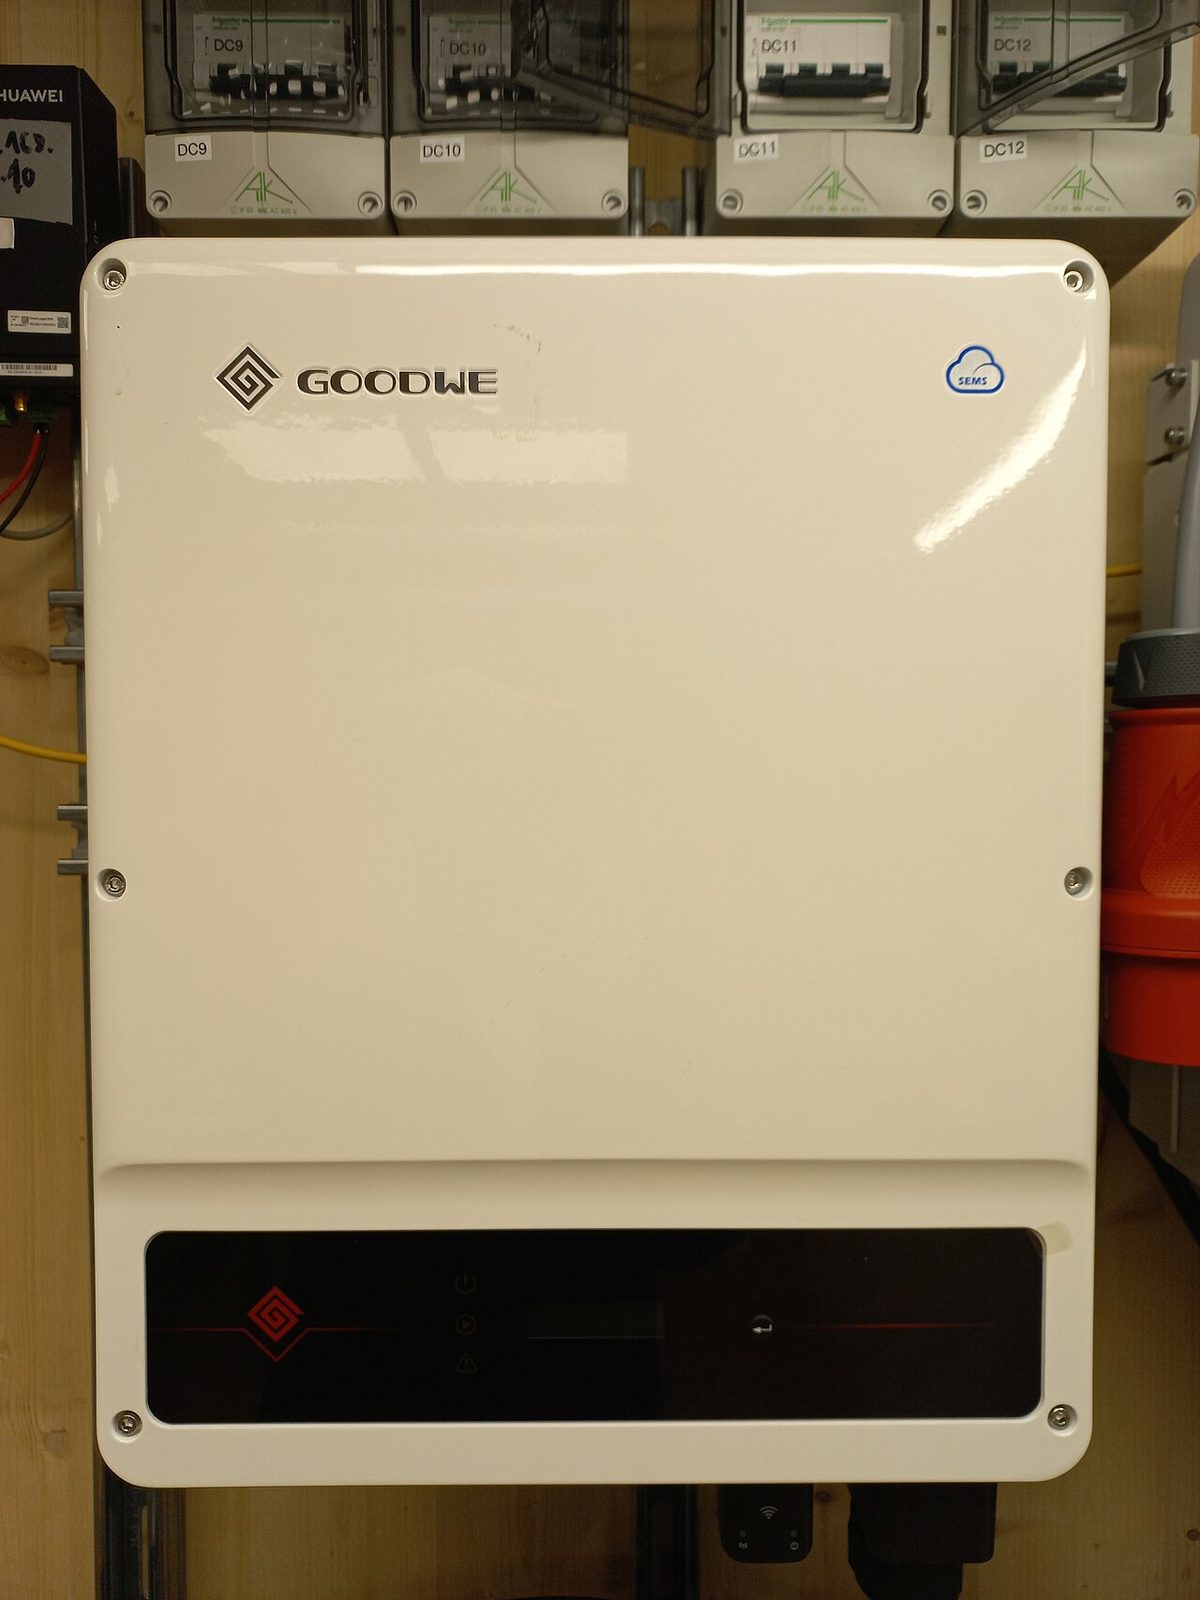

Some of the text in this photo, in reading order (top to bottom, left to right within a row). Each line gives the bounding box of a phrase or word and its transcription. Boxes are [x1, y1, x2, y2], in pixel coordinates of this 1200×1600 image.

[214, 38, 243, 52] DC9
[449, 42, 486, 56] DC10
[761, 38, 797, 53] DC11
[994, 38, 1031, 51] DC12
[0, 89, 64, 103] HUAWEI
[177, 142, 208, 157] DC9
[423, 144, 461, 158] DC10
[738, 141, 776, 157] DC11
[983, 140, 1025, 157] DC12
[297, 368, 498, 396] GOODWE
[958, 376, 987, 386] SEMS
